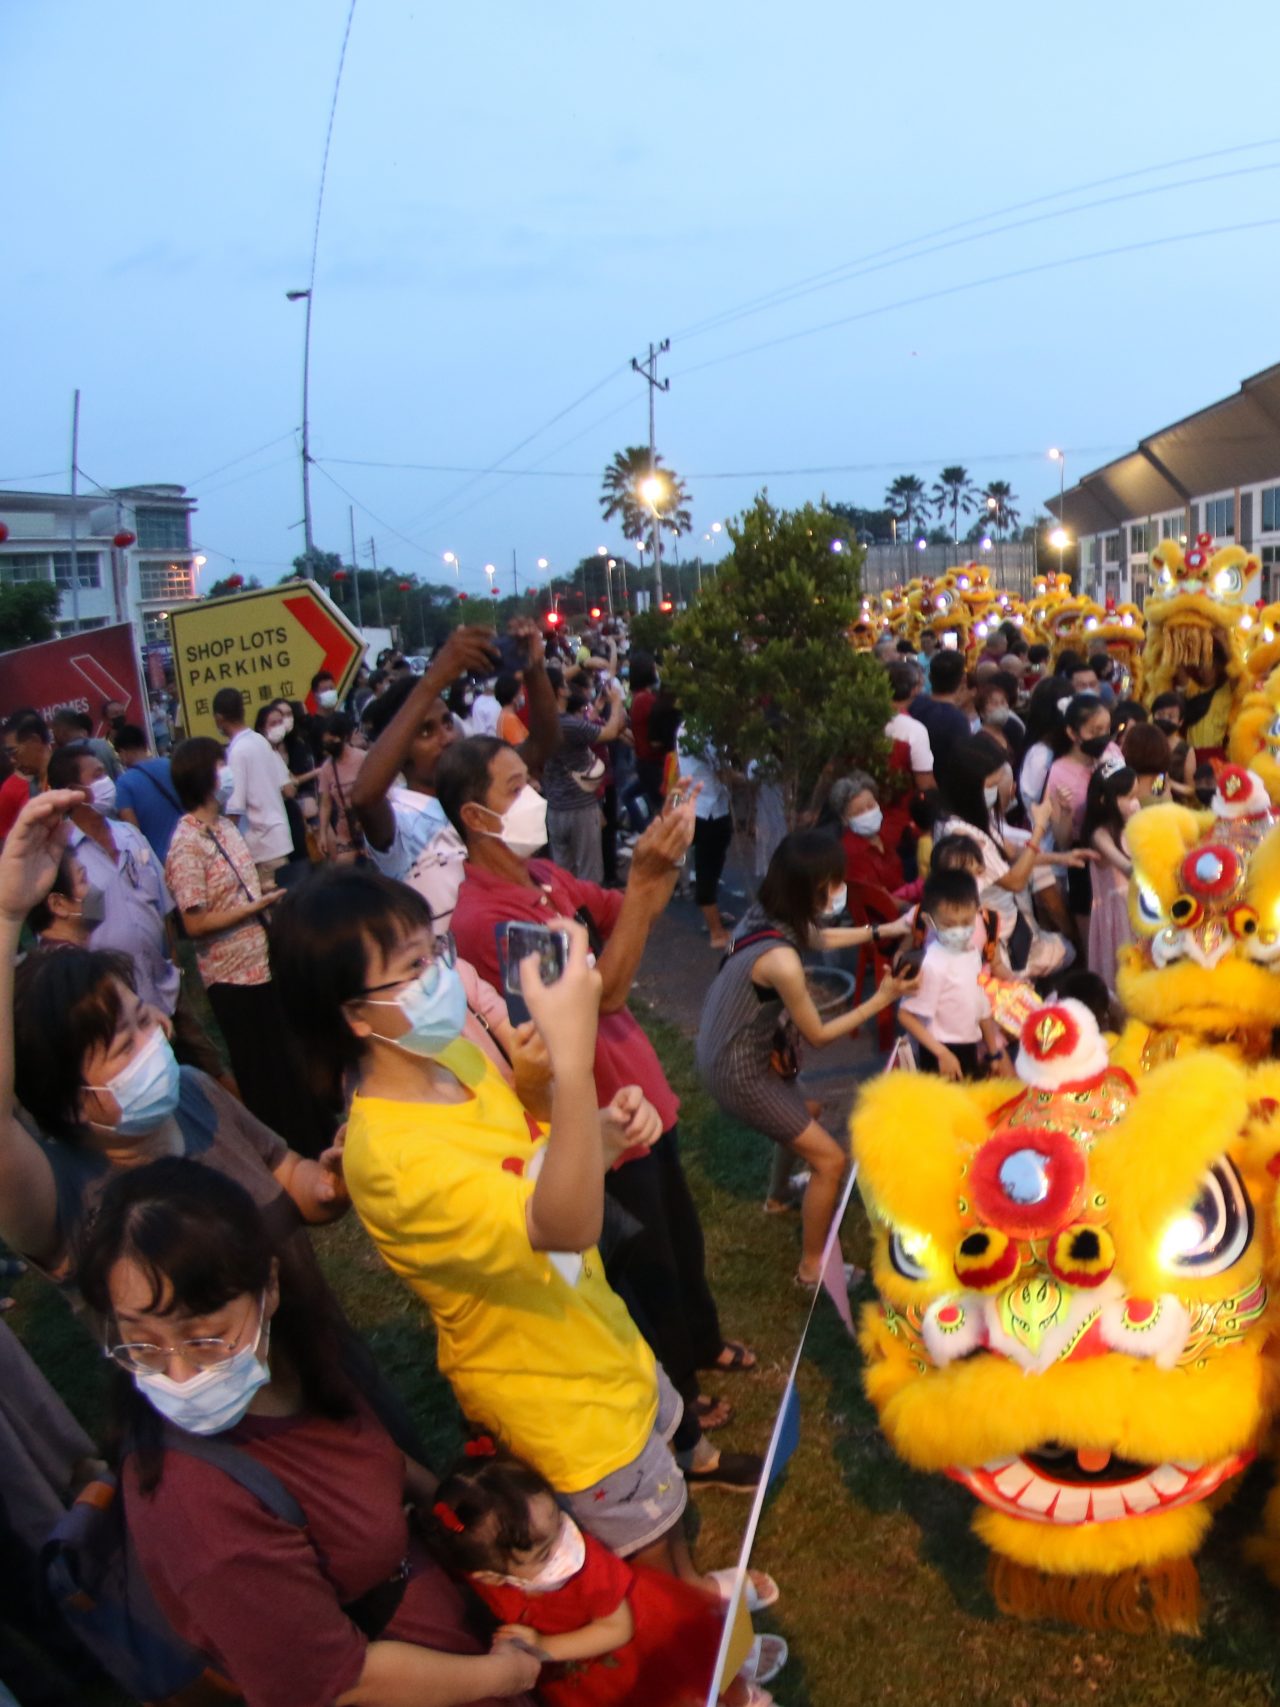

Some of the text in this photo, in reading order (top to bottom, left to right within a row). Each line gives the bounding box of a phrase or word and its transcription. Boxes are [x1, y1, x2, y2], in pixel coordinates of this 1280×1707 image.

[187, 627, 288, 663] SHOP LOTS
[190, 651, 290, 686] PARKING
